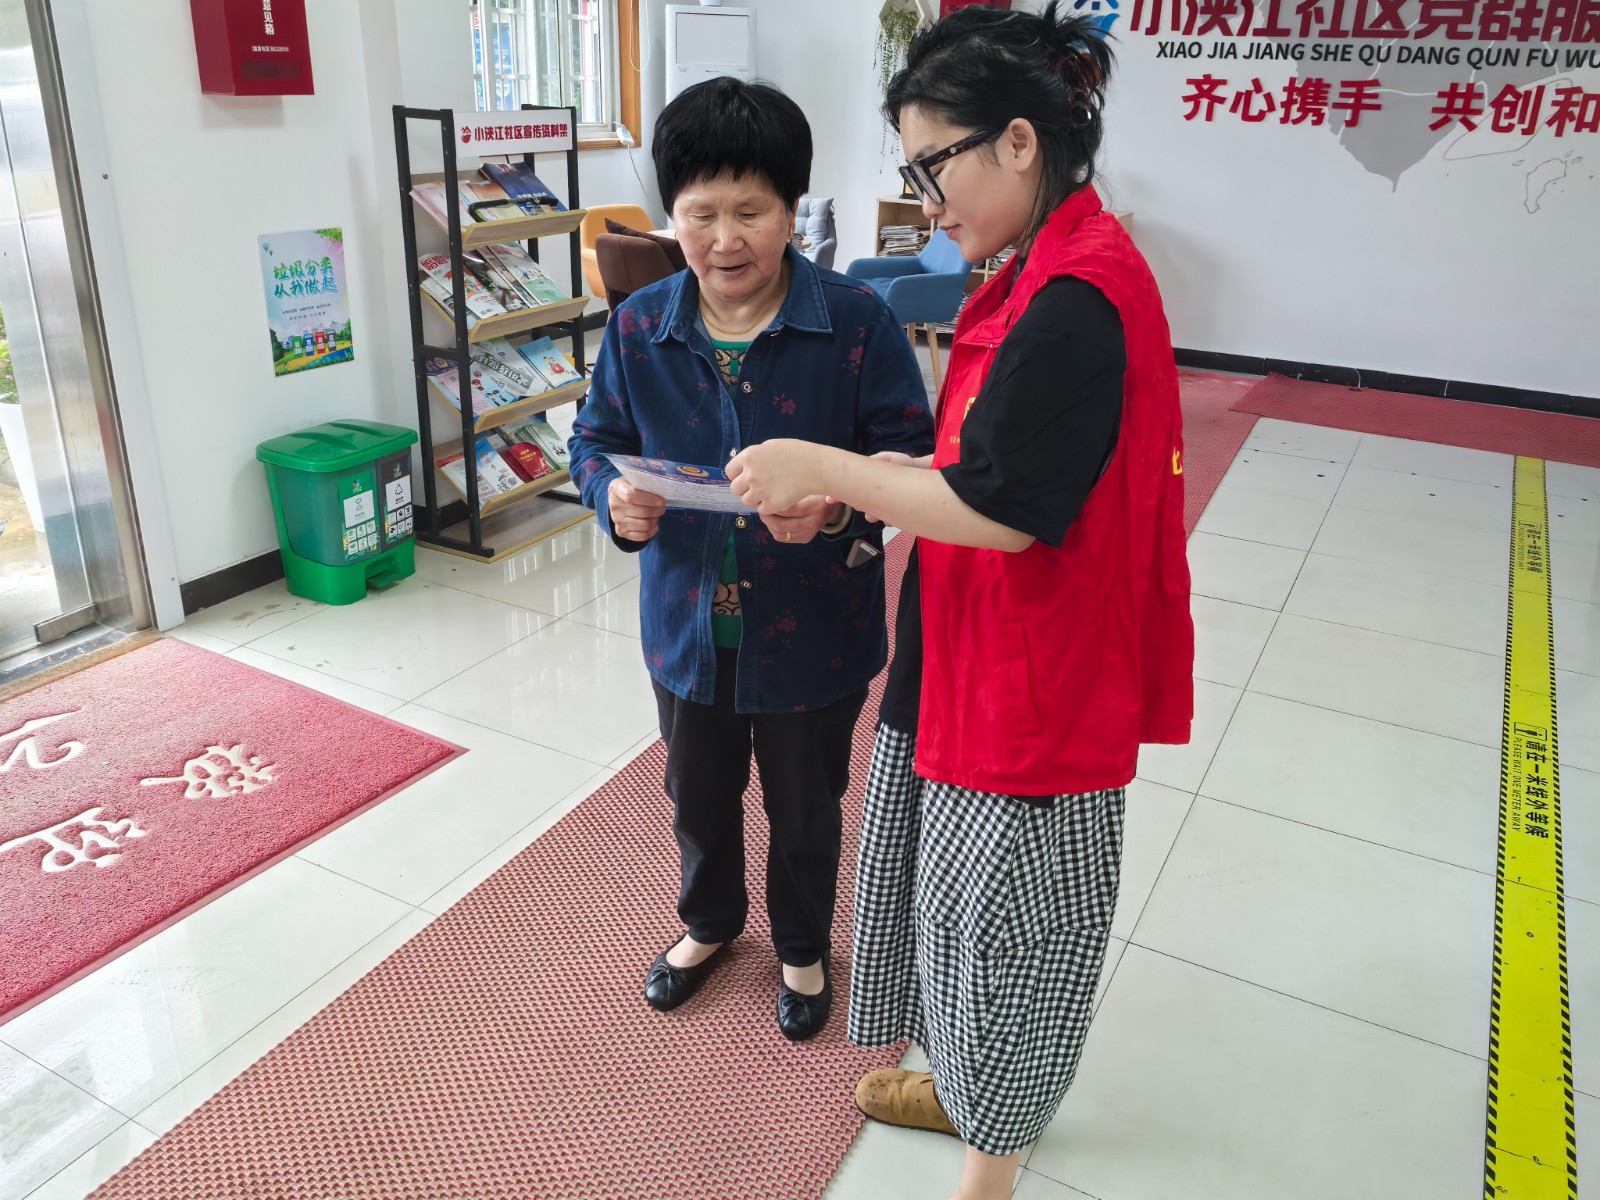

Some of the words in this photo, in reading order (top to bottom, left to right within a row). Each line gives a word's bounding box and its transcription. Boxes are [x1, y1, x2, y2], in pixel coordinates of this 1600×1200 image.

[1156, 41, 1203, 59] XIAO
[1206, 42, 1238, 59] JIA
[1242, 42, 1305, 61] JIANG
[1310, 43, 1354, 62] SHE
[1358, 44, 1392, 66] QU
[1396, 46, 1461, 65] DANG
[1466, 47, 1521, 70] QUN
[1525, 48, 1559, 68] FU
[1565, 49, 1600, 69] WU
[1181, 73, 1383, 129] 齐心携手
[1428, 82, 1600, 138] 共创和
[474, 123, 568, 142] 小浃江社区宣传资料架
[273, 256, 334, 281] 垃圾分类
[274, 276, 339, 299] 从我做起
[1513, 737, 1523, 759] PLEASE
[1513, 759, 1522, 774] WAIT
[1512, 775, 1522, 788] ONE
[1525, 740, 1549, 838] 请在一米线外等候
[1512, 789, 1521, 810] METER
[1511, 812, 1521, 832] AWAY
